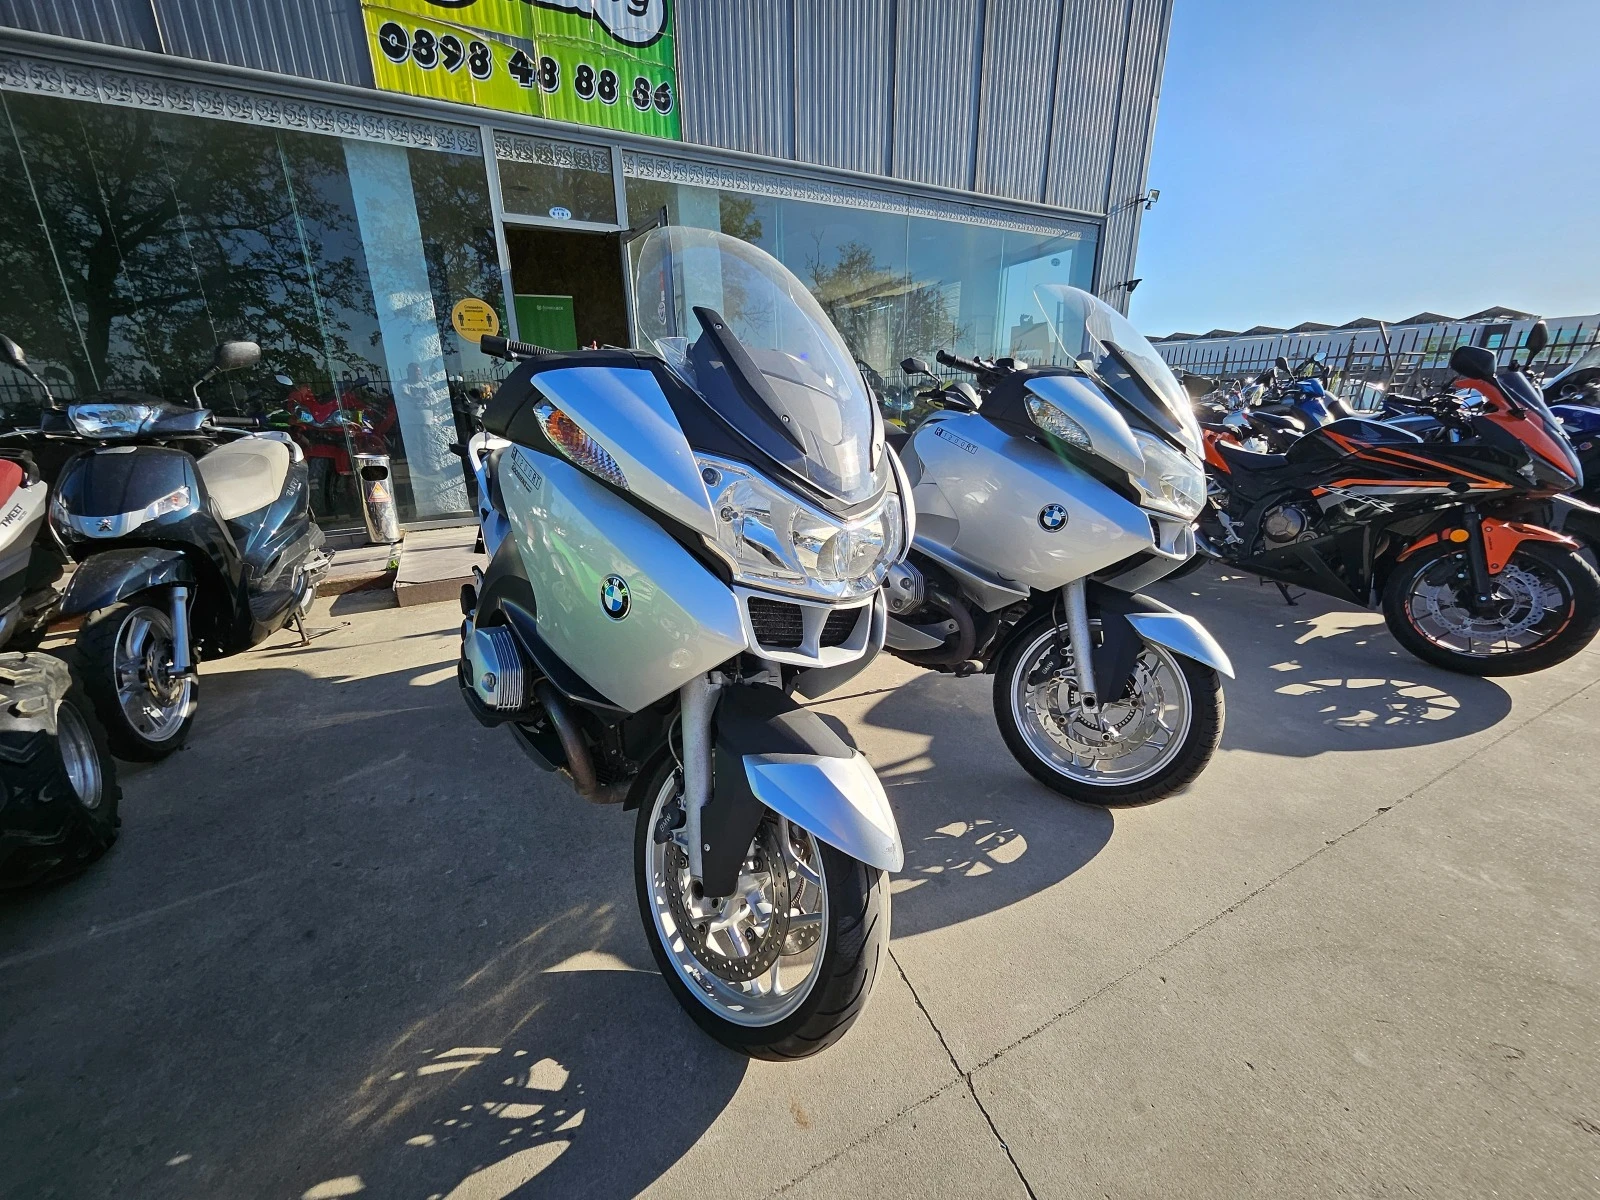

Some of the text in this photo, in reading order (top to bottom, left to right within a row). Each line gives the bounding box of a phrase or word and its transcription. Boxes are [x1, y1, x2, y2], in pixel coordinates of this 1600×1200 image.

[379, 21, 675, 115] 0898 48 88 86
[0, 502, 23, 527] TWEET
[659, 812, 672, 833] BMW
